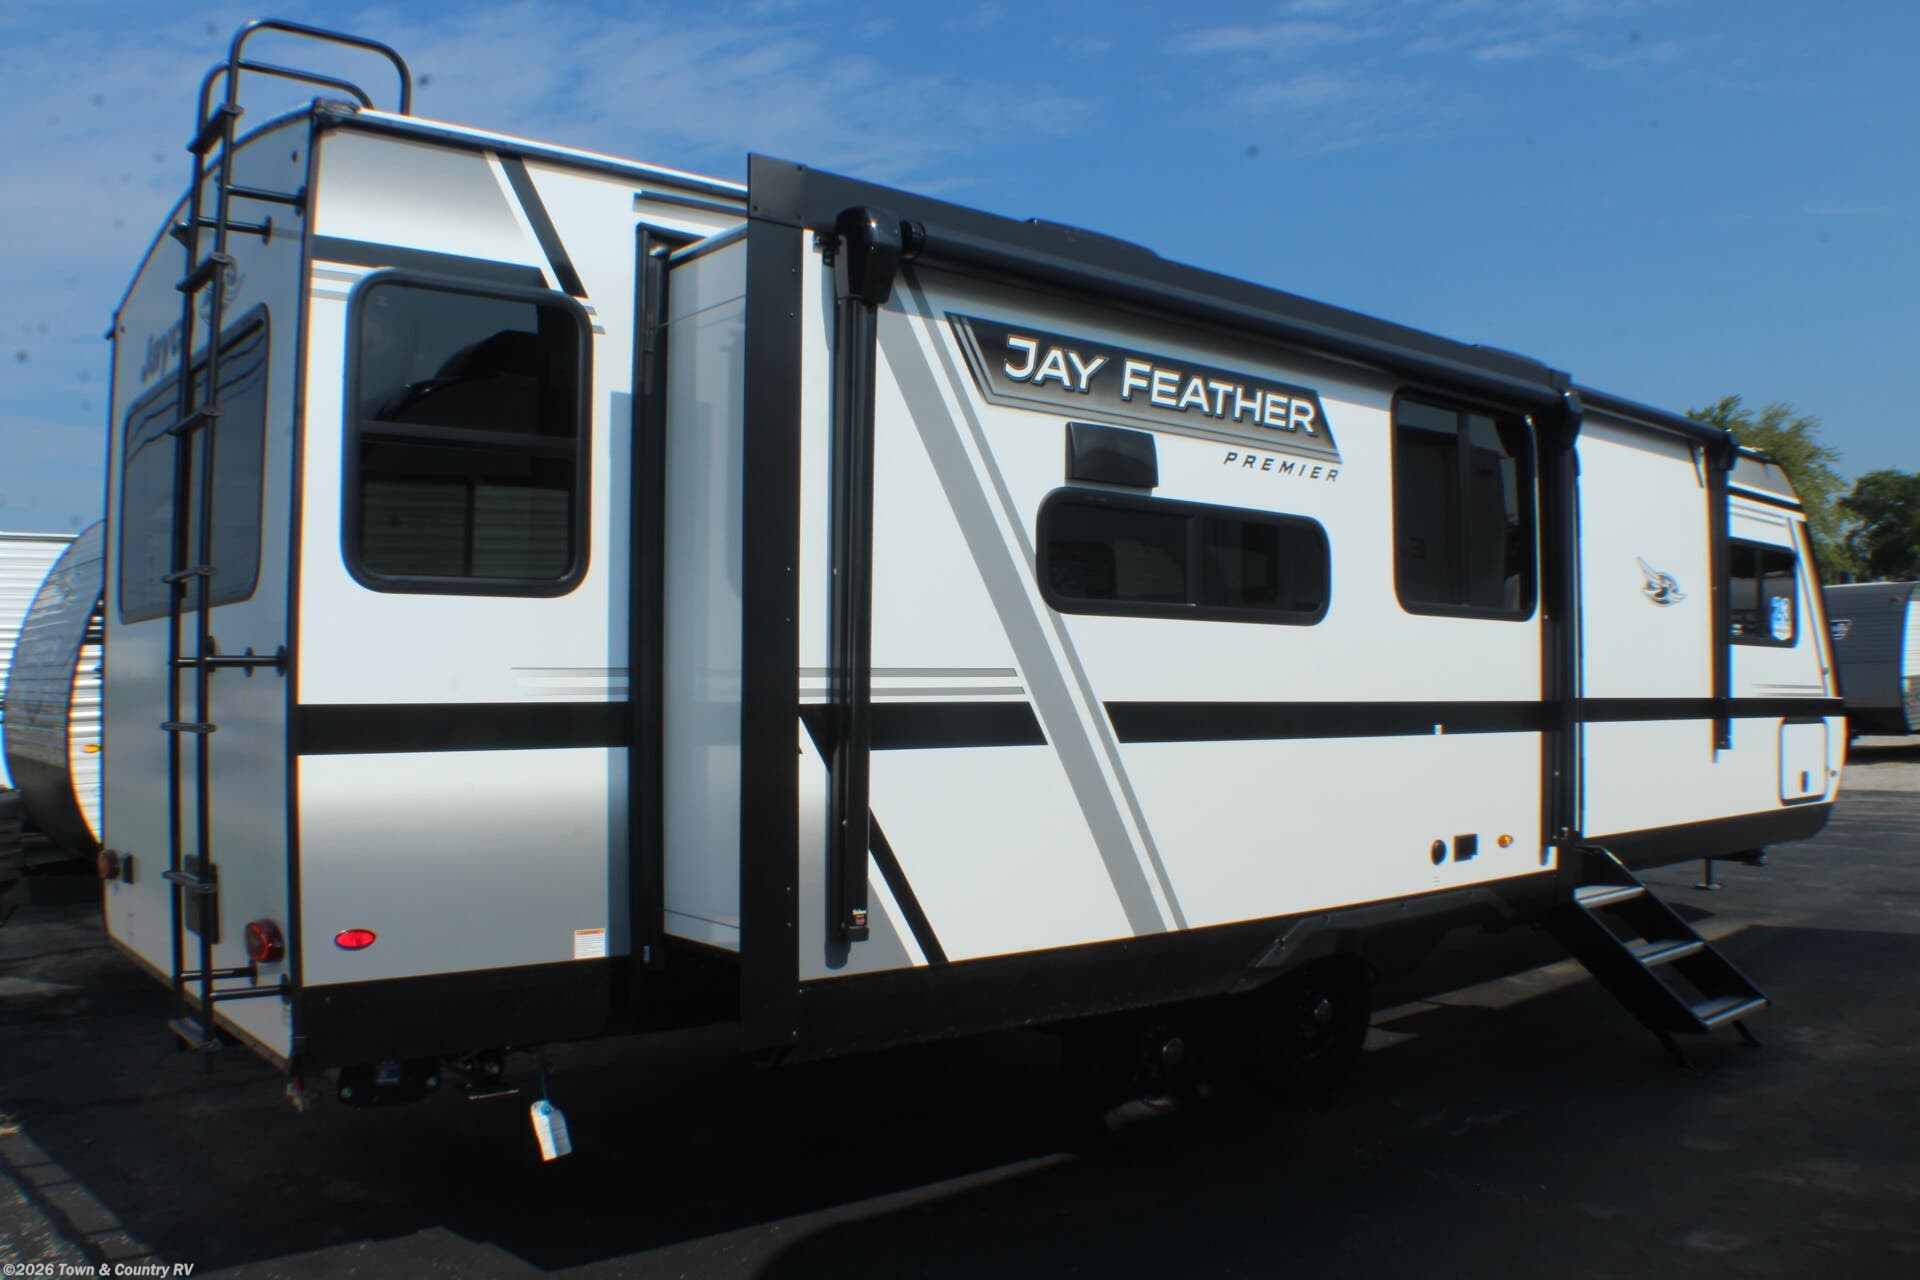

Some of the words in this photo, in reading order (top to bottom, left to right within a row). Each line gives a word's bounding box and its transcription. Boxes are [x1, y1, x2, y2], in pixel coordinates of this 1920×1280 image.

[1004, 335, 1109, 393] JAY
[1121, 359, 1319, 436] FEATHER
[1223, 451, 1340, 482] PREMIER
